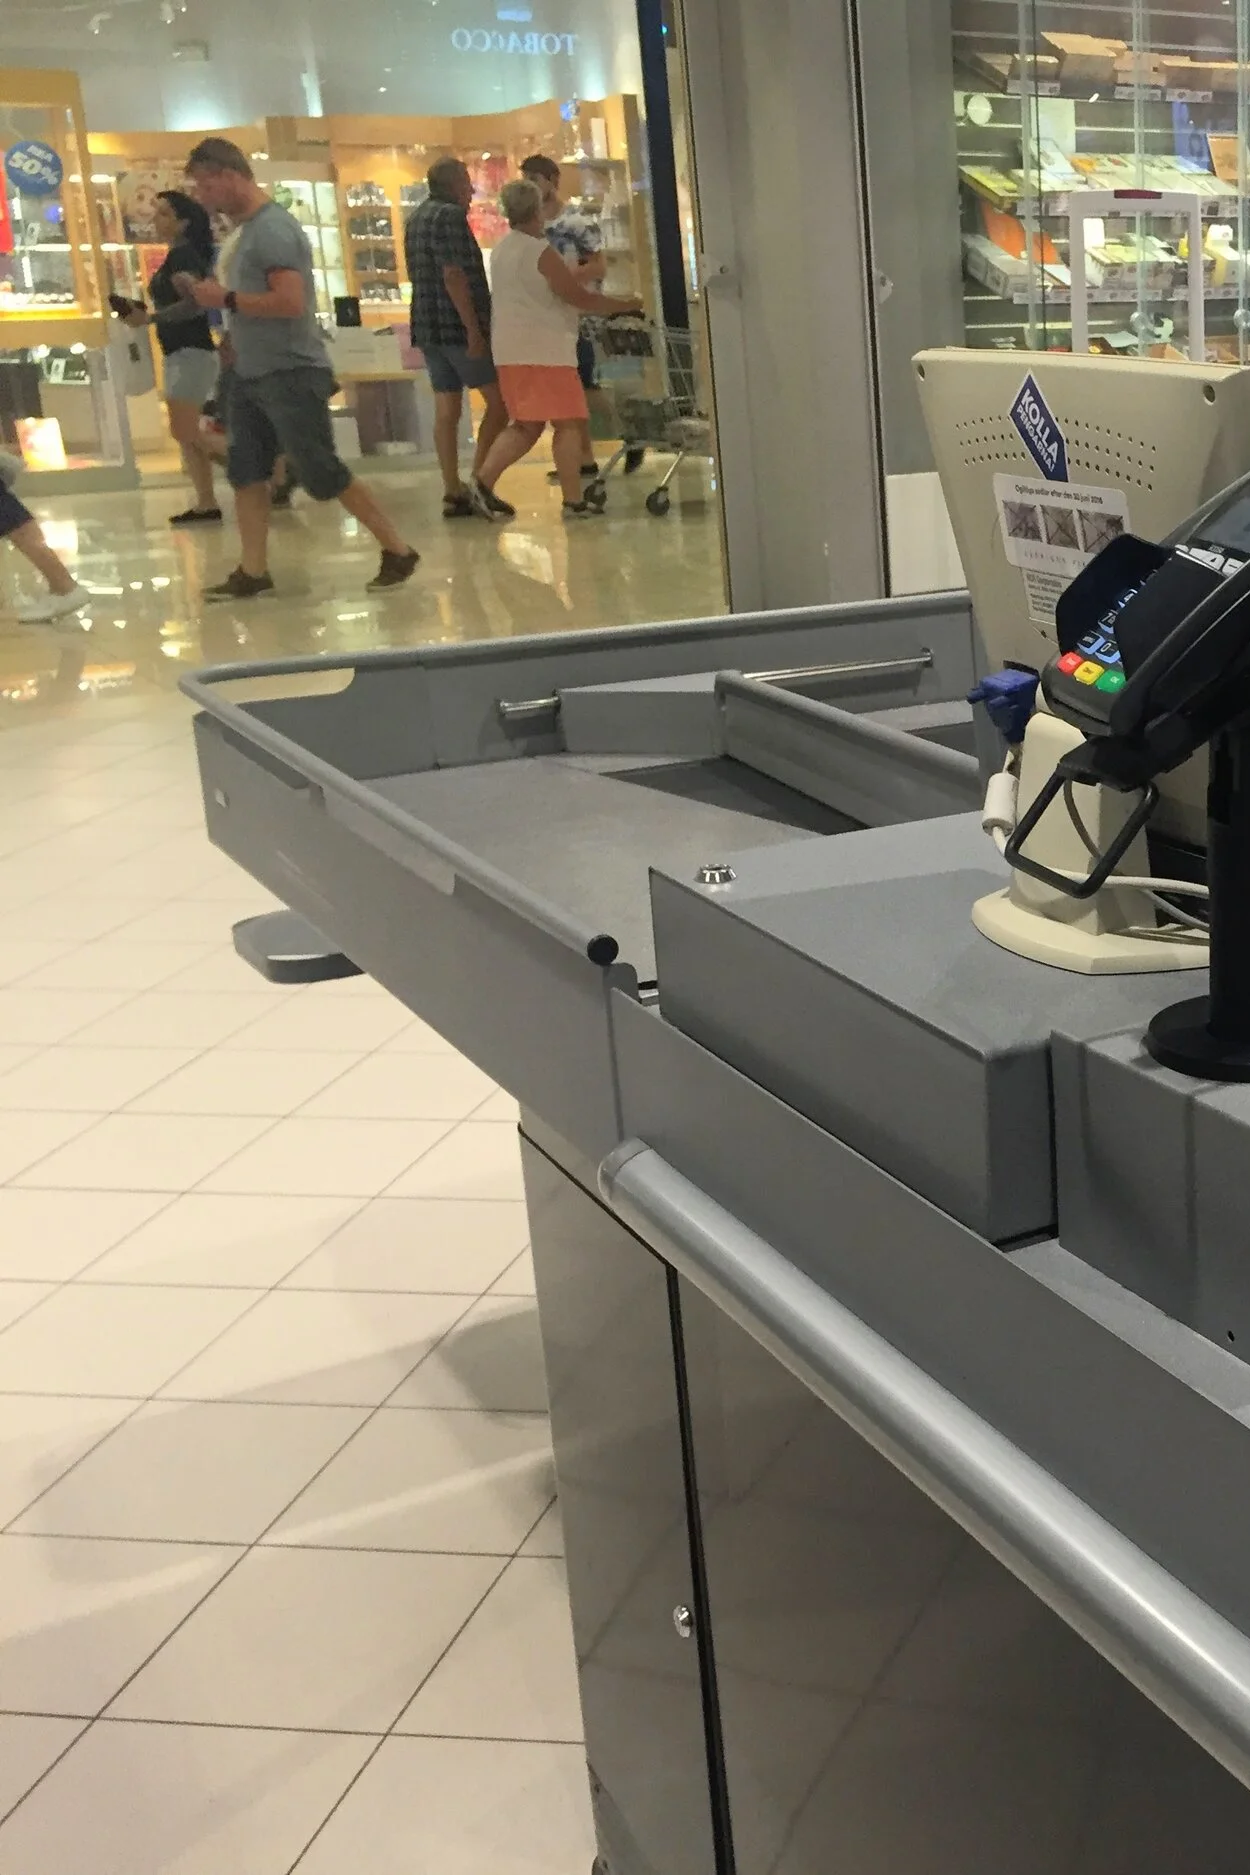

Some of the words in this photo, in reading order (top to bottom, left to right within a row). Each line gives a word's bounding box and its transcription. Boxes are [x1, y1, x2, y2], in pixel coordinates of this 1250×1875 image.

[9, 151, 61, 185] 50%
[1017, 404, 1055, 472] PENGARNA!
[1021, 388, 1058, 464] KOLLA
